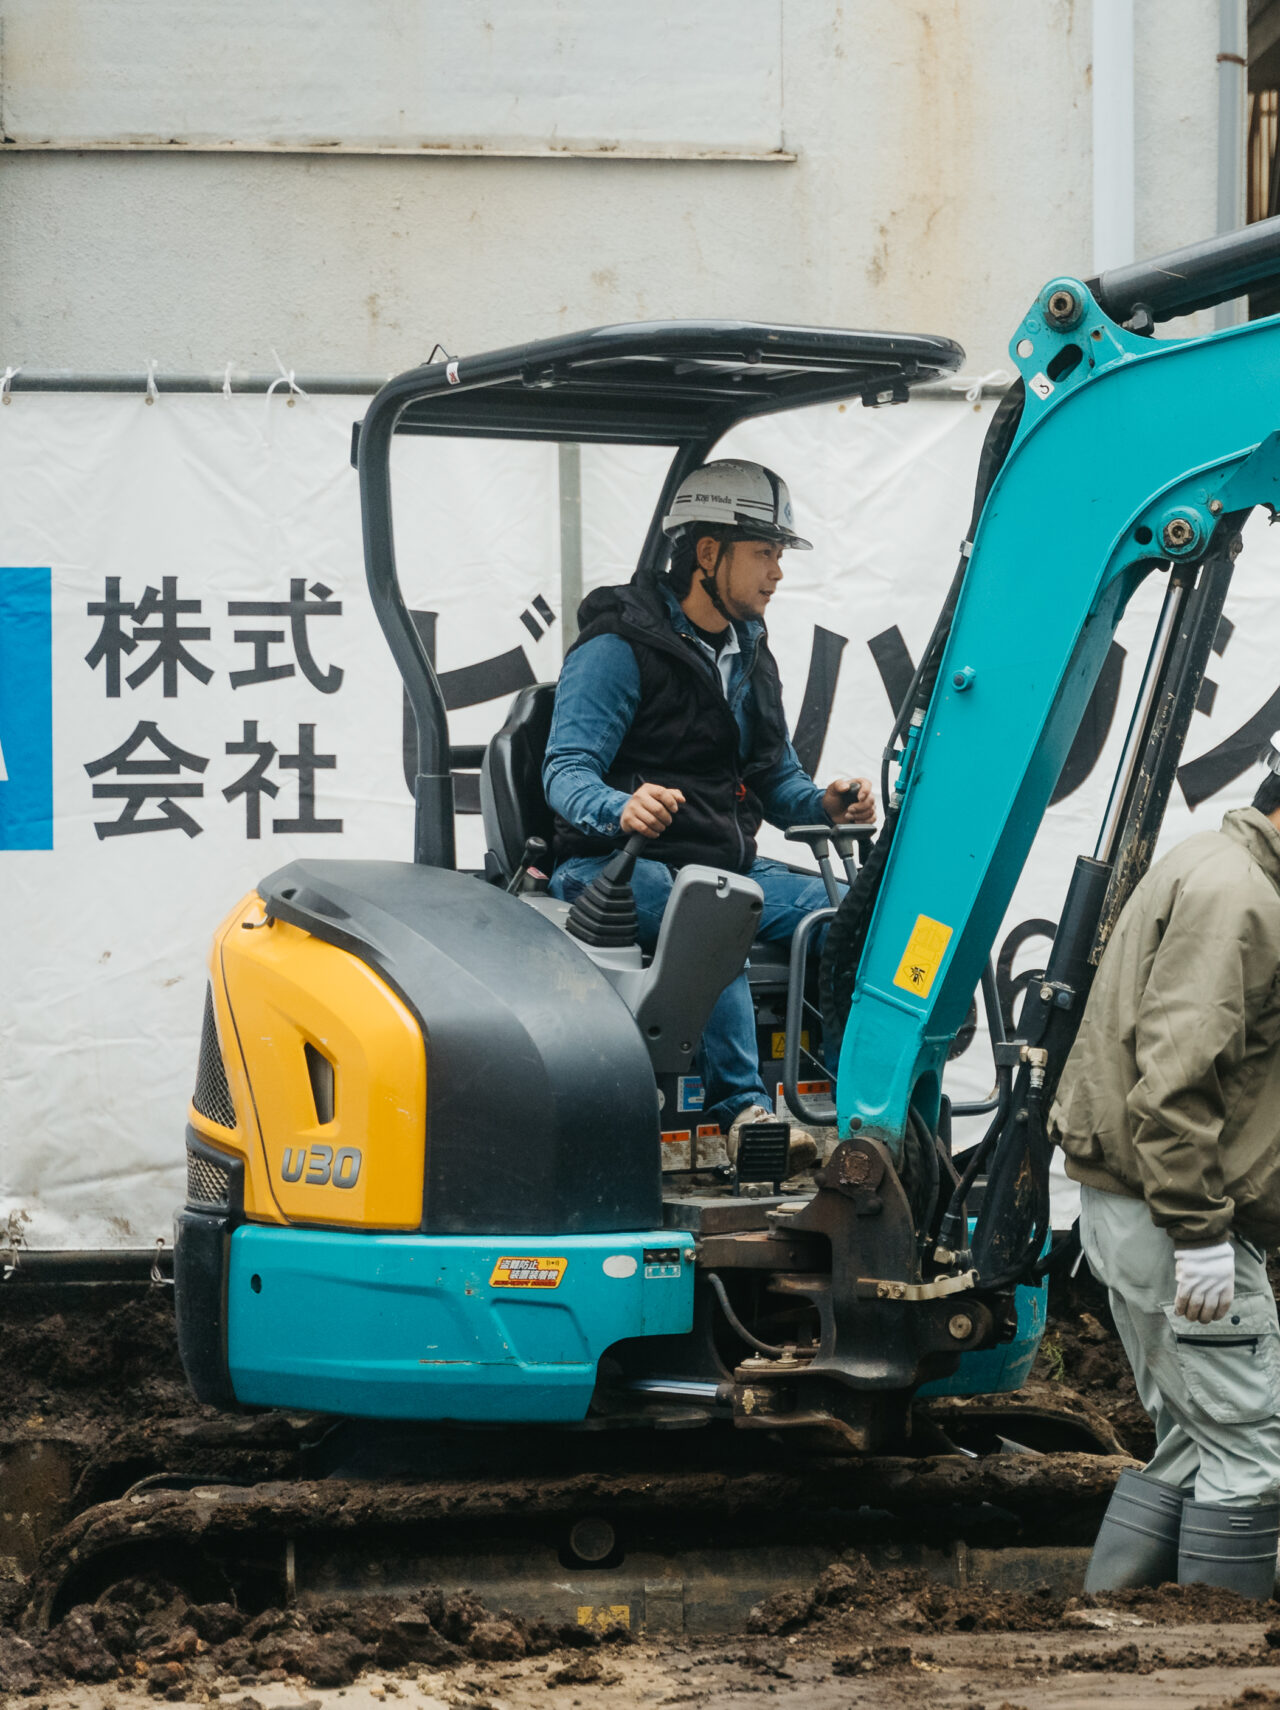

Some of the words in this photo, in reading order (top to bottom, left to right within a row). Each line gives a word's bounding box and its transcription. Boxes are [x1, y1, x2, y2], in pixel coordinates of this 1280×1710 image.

[84, 576, 344, 698] 株式
[84, 720, 344, 839] 会社
[281, 1143, 362, 1190] U30
